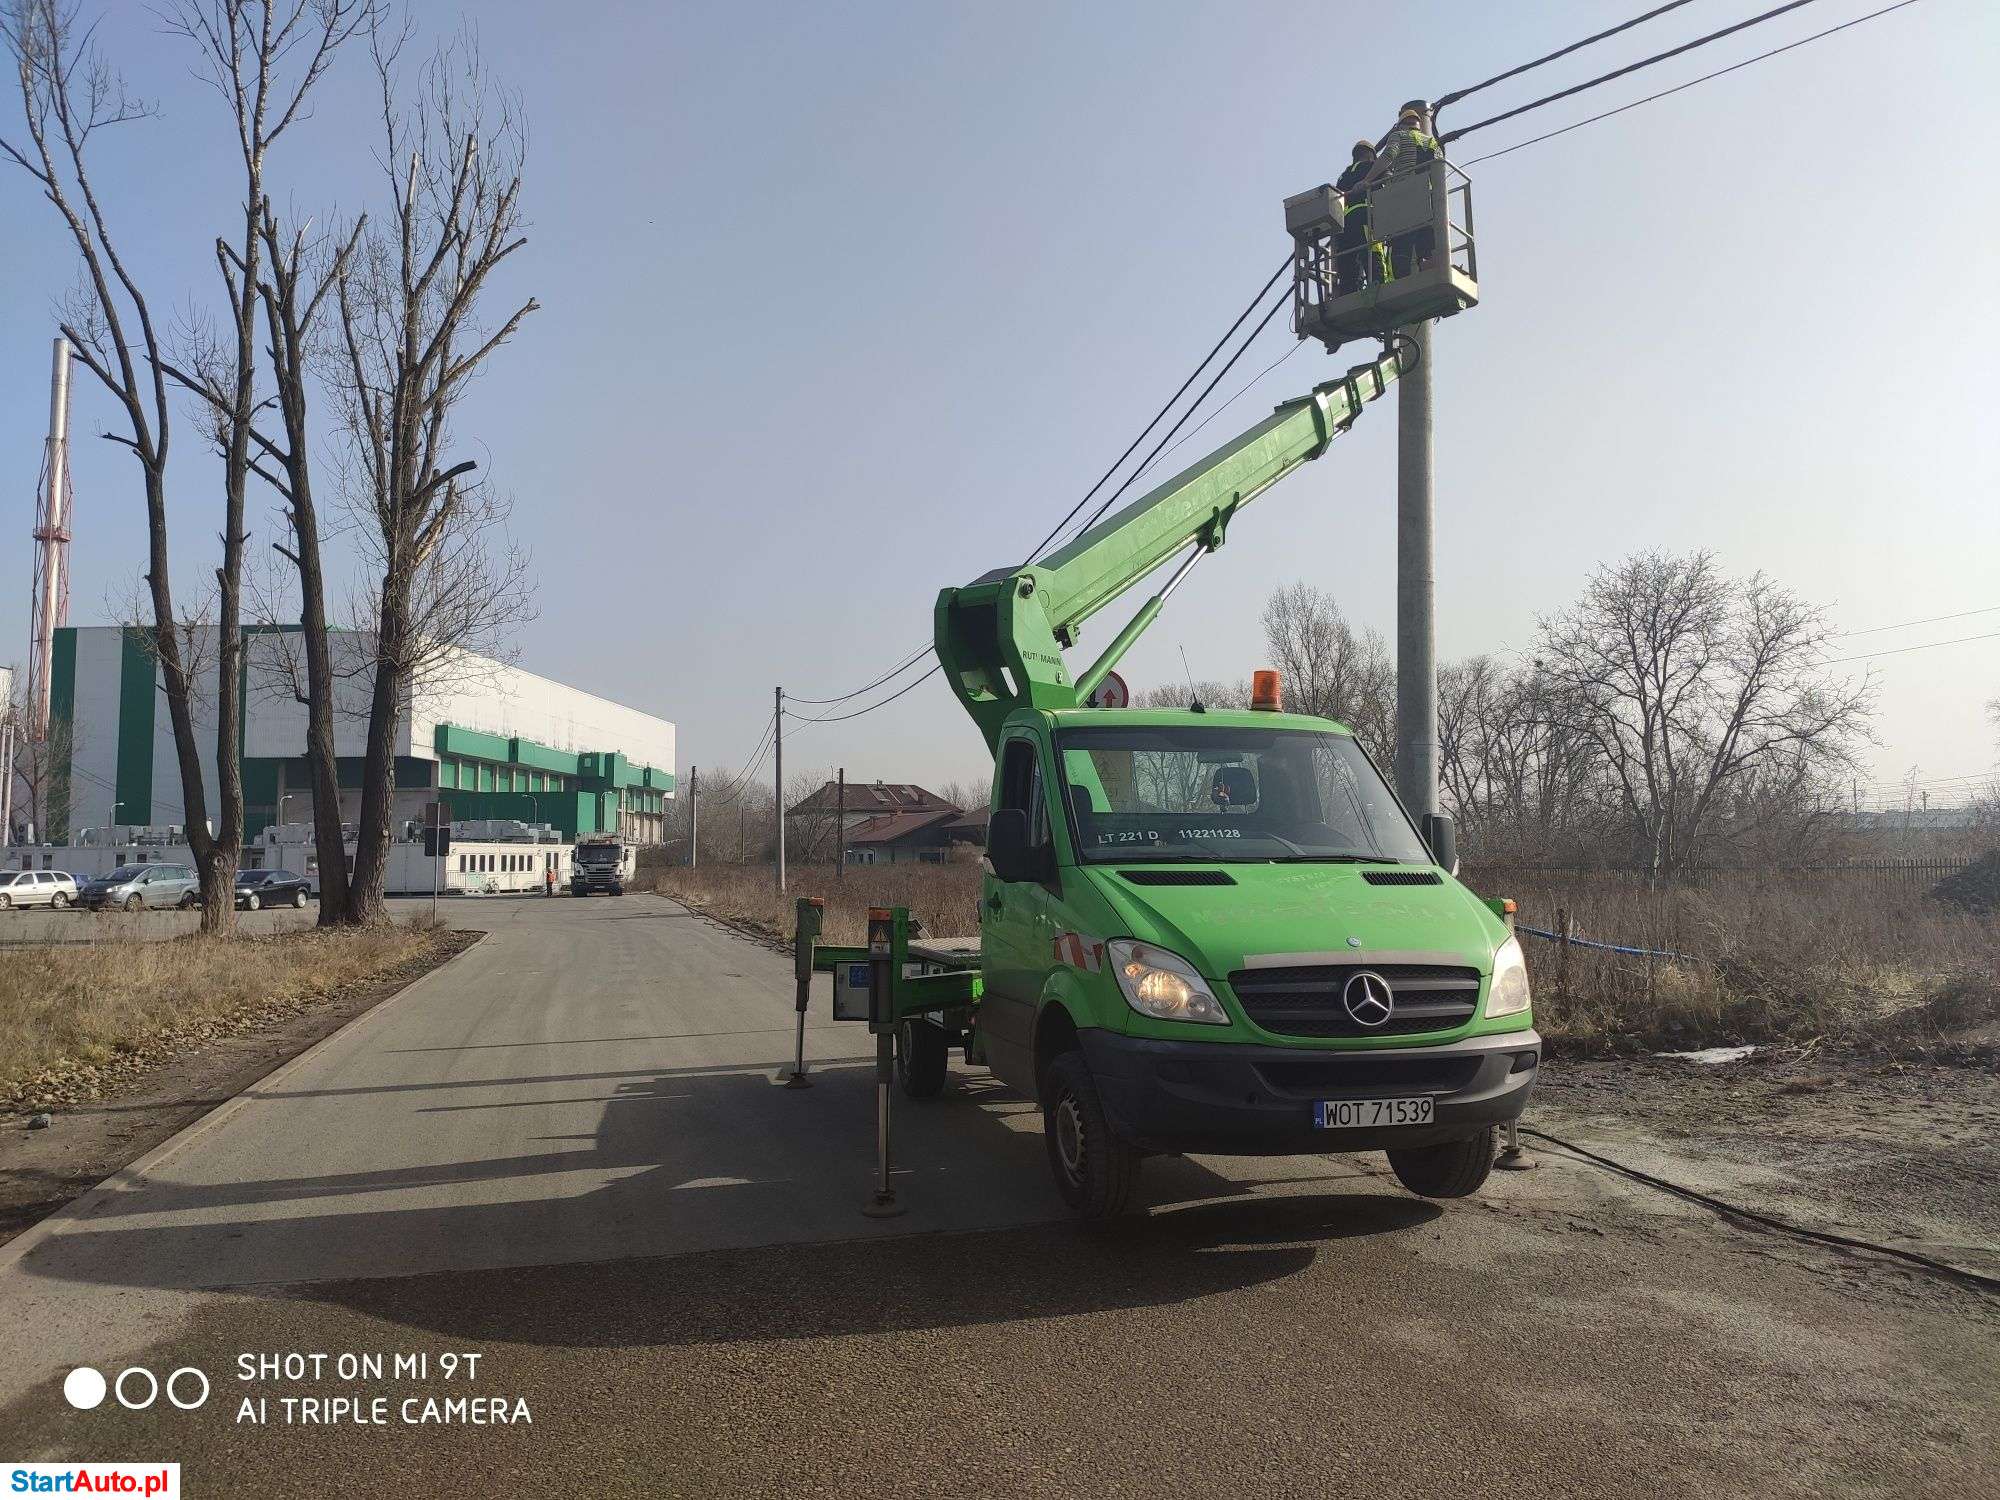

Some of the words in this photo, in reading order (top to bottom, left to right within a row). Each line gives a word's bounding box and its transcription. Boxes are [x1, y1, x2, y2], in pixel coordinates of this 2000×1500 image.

[1098, 833, 1114, 844] LT
[1119, 831, 1142, 842] 221
[1148, 831, 1159, 840] D
[1178, 829, 1241, 839] 11221128
[1325, 1102, 1364, 1126] WOT
[1371, 1099, 1431, 1124] 71539
